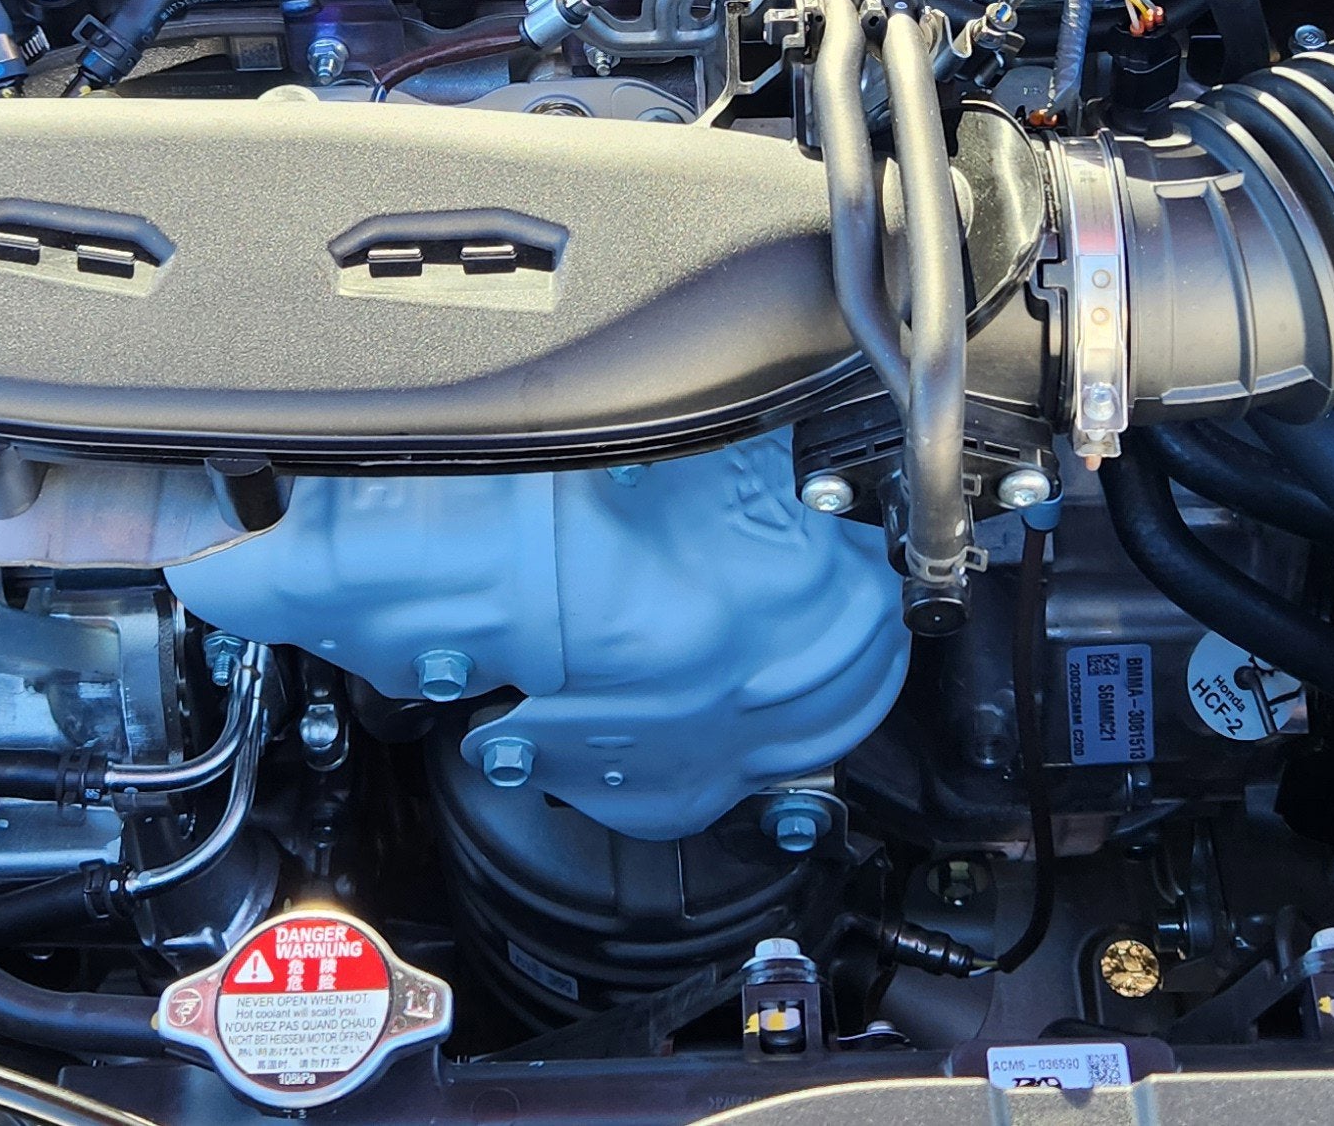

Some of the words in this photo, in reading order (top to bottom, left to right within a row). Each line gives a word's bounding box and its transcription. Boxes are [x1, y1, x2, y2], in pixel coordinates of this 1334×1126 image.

[1213, 675, 1246, 713] Honda
[1192, 678, 1243, 735] HCF-2
[275, 926, 348, 943] DANGER
[275, 942, 363, 959] WARNUNG
[237, 997, 274, 1008] NEVER
[277, 996, 307, 1007] OPEN
[311, 995, 343, 1006] WHEN
[236, 1009, 252, 1019] Hot
[256, 1008, 290, 1018] coolant
[279, 1020, 298, 1031] PAS
[302, 1019, 338, 1030] QUAND
[228, 1035, 253, 1045] NICHT
[308, 1032, 337, 1043] MOTOR
